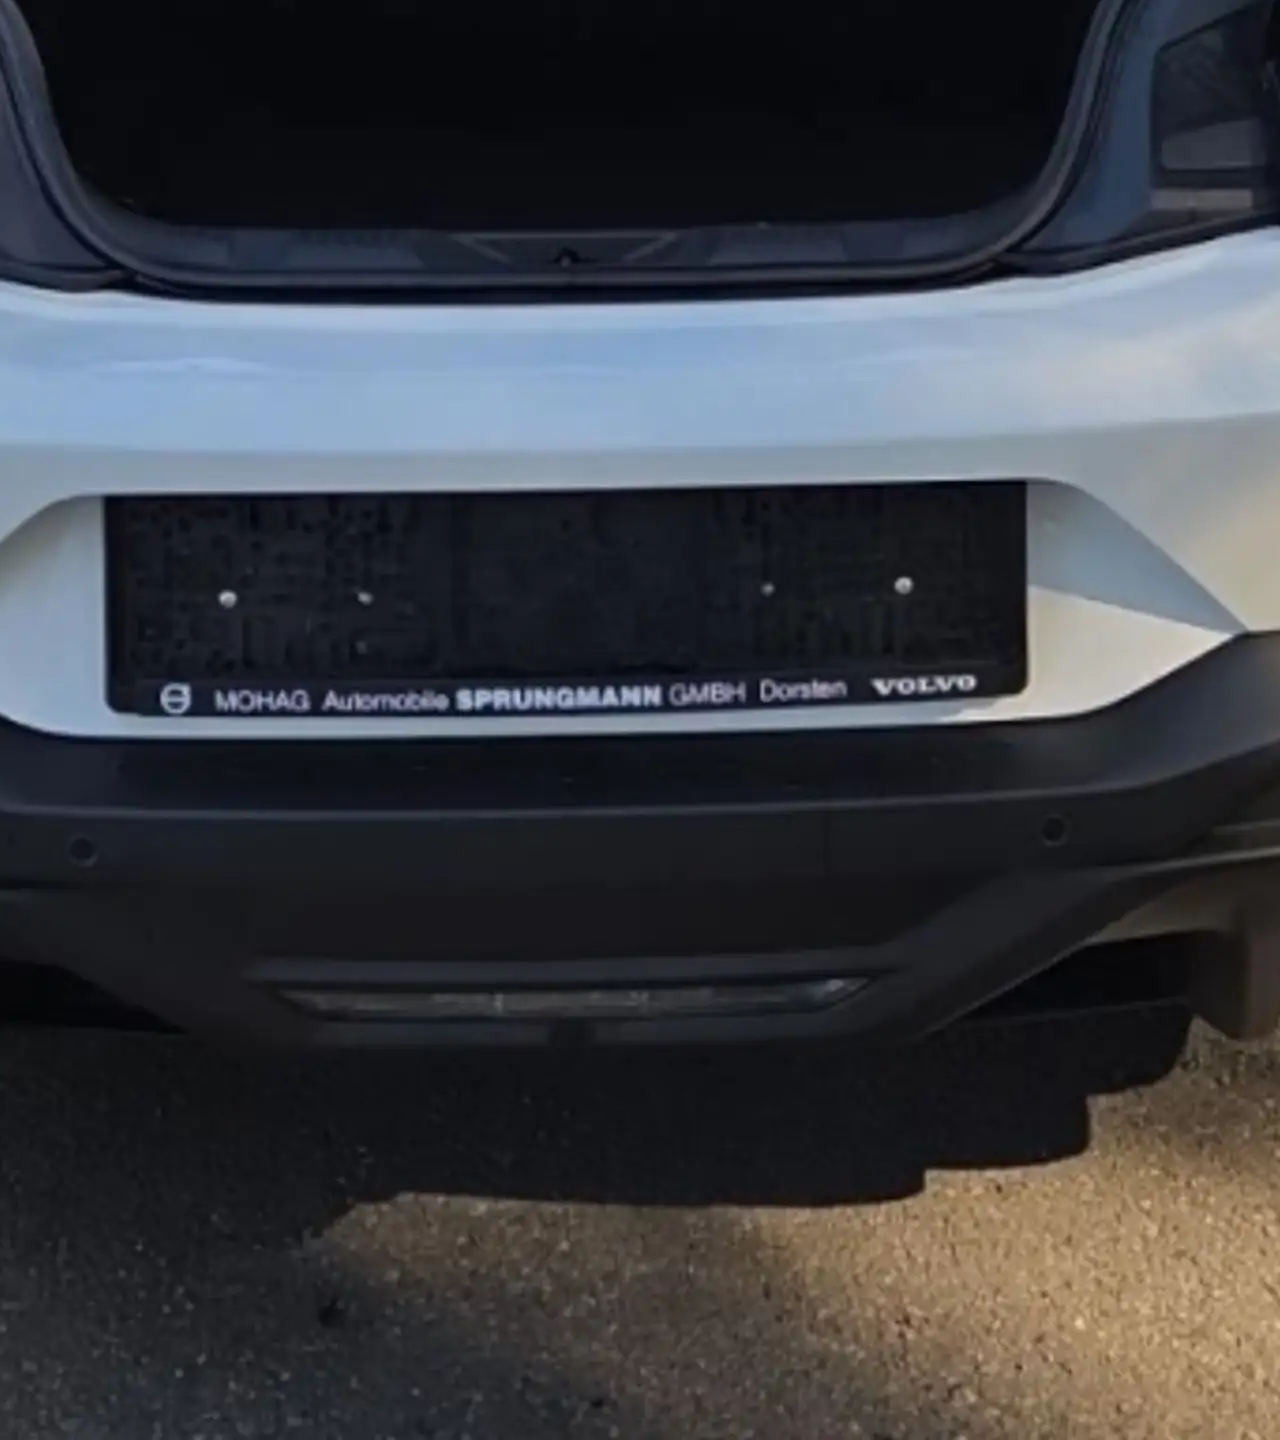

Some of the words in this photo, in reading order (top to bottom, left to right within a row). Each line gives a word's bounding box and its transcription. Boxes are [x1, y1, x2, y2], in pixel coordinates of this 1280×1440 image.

[215, 688, 311, 713] MOHAG
[322, 688, 450, 713] Automobile
[455, 685, 663, 711] SPRUNGMANN
[669, 682, 747, 705] GMBH
[759, 678, 848, 703] Dorsten
[871, 673, 977, 696] VOLVO
